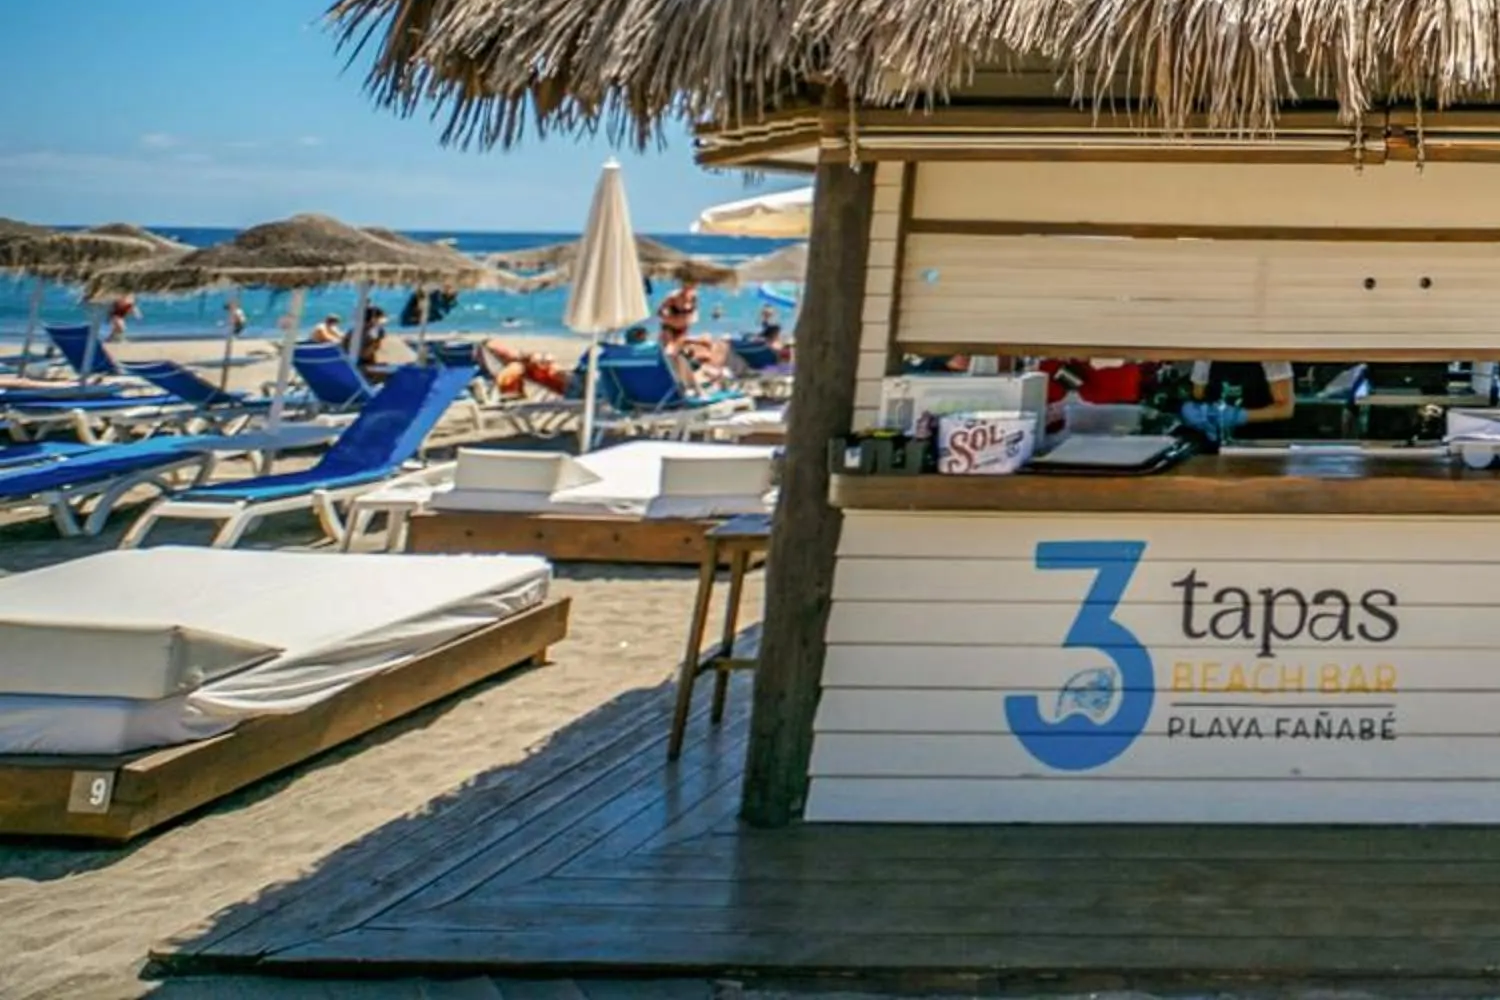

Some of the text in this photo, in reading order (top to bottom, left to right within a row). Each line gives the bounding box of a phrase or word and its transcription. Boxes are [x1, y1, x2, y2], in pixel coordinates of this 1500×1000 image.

[1004, 540, 1400, 772] 3 tapas
[1171, 662, 1398, 694] BEACH BAR
[1168, 712, 1397, 741] PLAYA FAÑABÉ
[89, 777, 107, 806] 9
